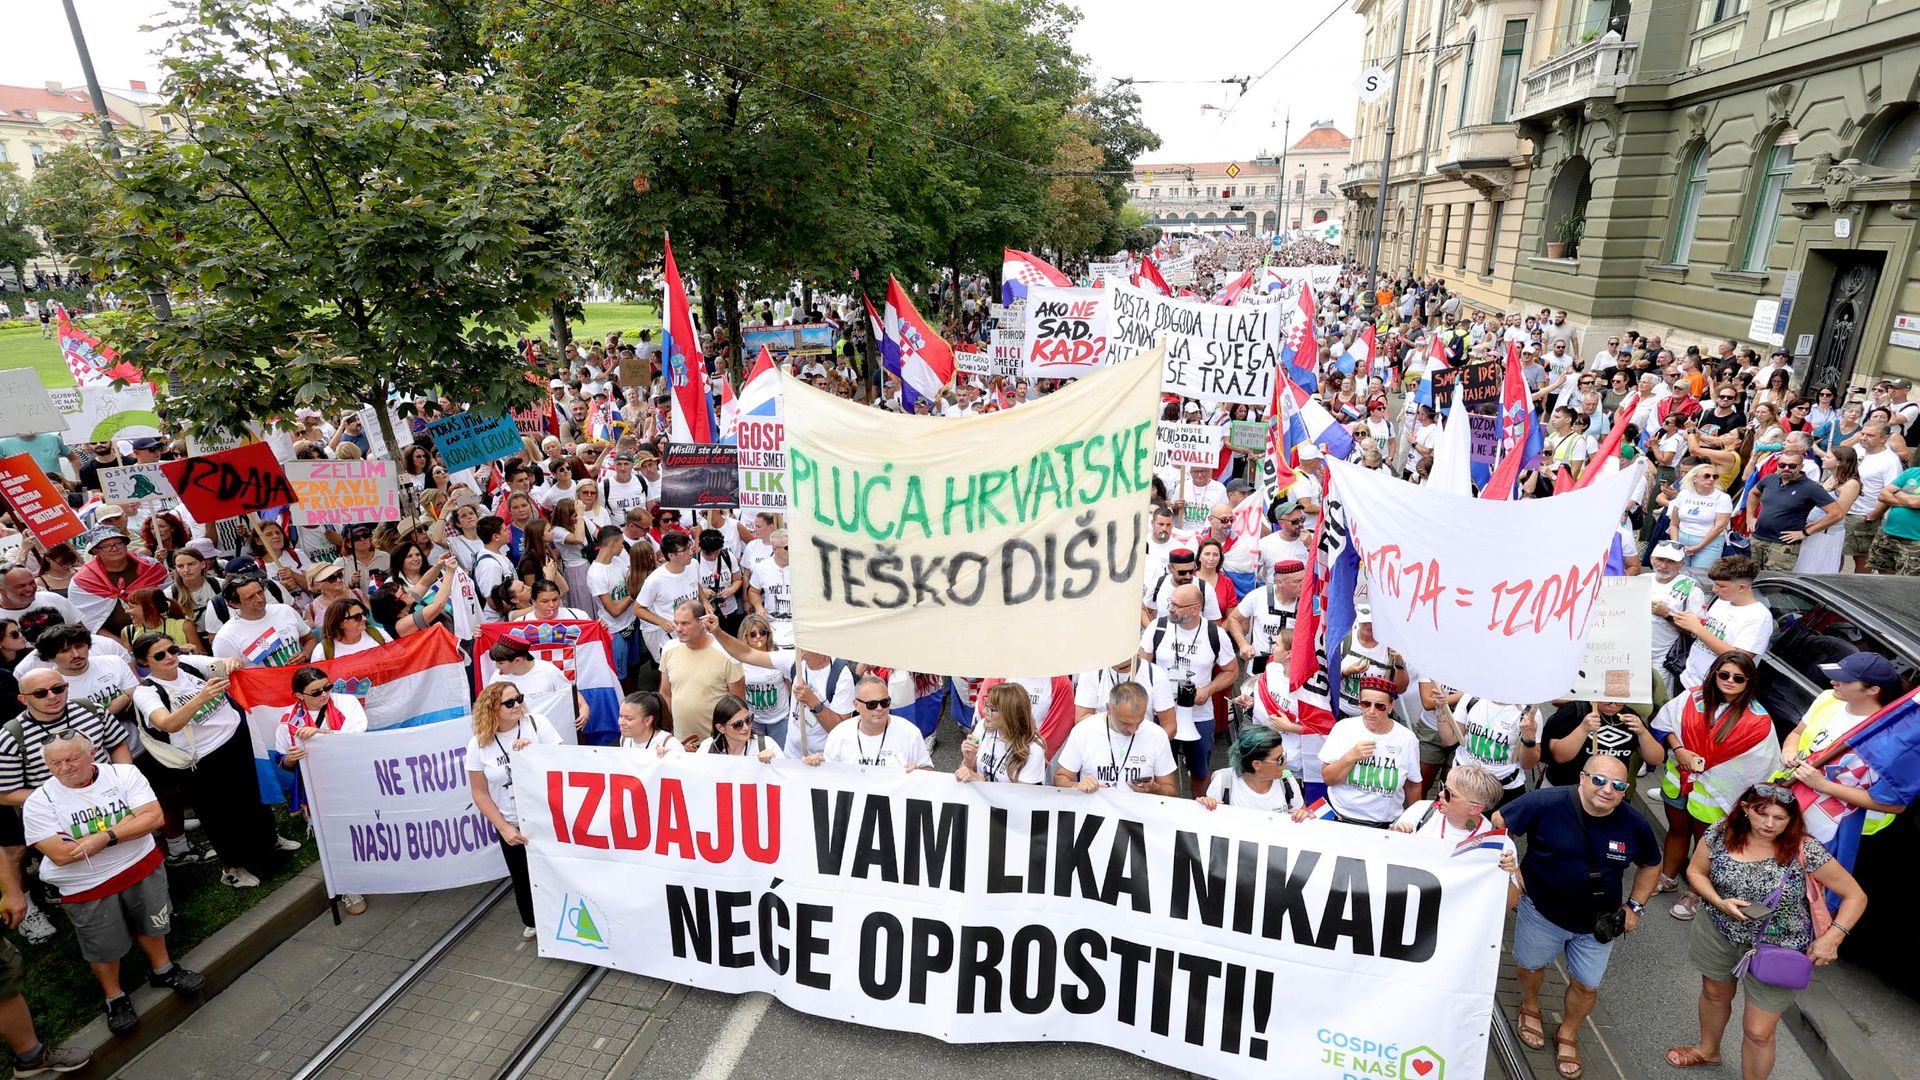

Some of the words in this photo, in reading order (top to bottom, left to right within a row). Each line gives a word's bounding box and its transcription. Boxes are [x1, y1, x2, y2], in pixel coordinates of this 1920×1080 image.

[1366, 76, 1378, 91] S
[1034, 301, 1069, 318] AKO
[1070, 300, 1099, 317] NE
[1113, 287, 1150, 323] DOSTA
[1155, 302, 1203, 339] ODGODA
[1212, 312, 1218, 340] I
[1228, 308, 1268, 343] LAŽI
[1037, 318, 1093, 341] SAD,
[1030, 336, 1106, 364] KAD?
[1203, 341, 1278, 372] SVEGA
[1166, 360, 1188, 386] SE
[1199, 367, 1269, 398] TRAŽI
[1478, 363, 1496, 382] IDE
[428, 417, 461, 439] MORAŠ
[446, 434, 461, 445] KAD
[463, 430, 473, 440] SE
[442, 441, 482, 467] RODNA
[482, 428, 522, 456] GRUDA
[698, 446, 710, 454] ste
[711, 446, 721, 454] da
[740, 452, 761, 467] NIJE
[290, 478, 378, 496] ZDRAVU
[745, 471, 784, 493] LIK
[789, 447, 932, 541] PLUĆA
[943, 420, 1152, 536] HRVATSKE
[741, 492, 760, 505] NIJE
[811, 534, 988, 608] TEŠKO
[1002, 510, 1142, 605] DIŠU
[1496, 733, 1509, 746] ZA
[1384, 757, 1396, 769] ZA
[374, 758, 406, 796] NE
[111, 798, 129, 815] ZA
[349, 808, 401, 862] NAŠU
[546, 770, 781, 864] IZDAJU
[810, 788, 969, 893] VAM
[986, 805, 1152, 914] LIKA
[1169, 830, 1442, 963] NIKAD
[665, 877, 834, 990] NEĆE
[858, 911, 1274, 1061] OPROSTITI!
[1317, 1028, 1399, 1060] GOSPIĆ
[1321, 1048, 1346, 1068] JE
[1352, 1056, 1397, 1078] NAŠ
